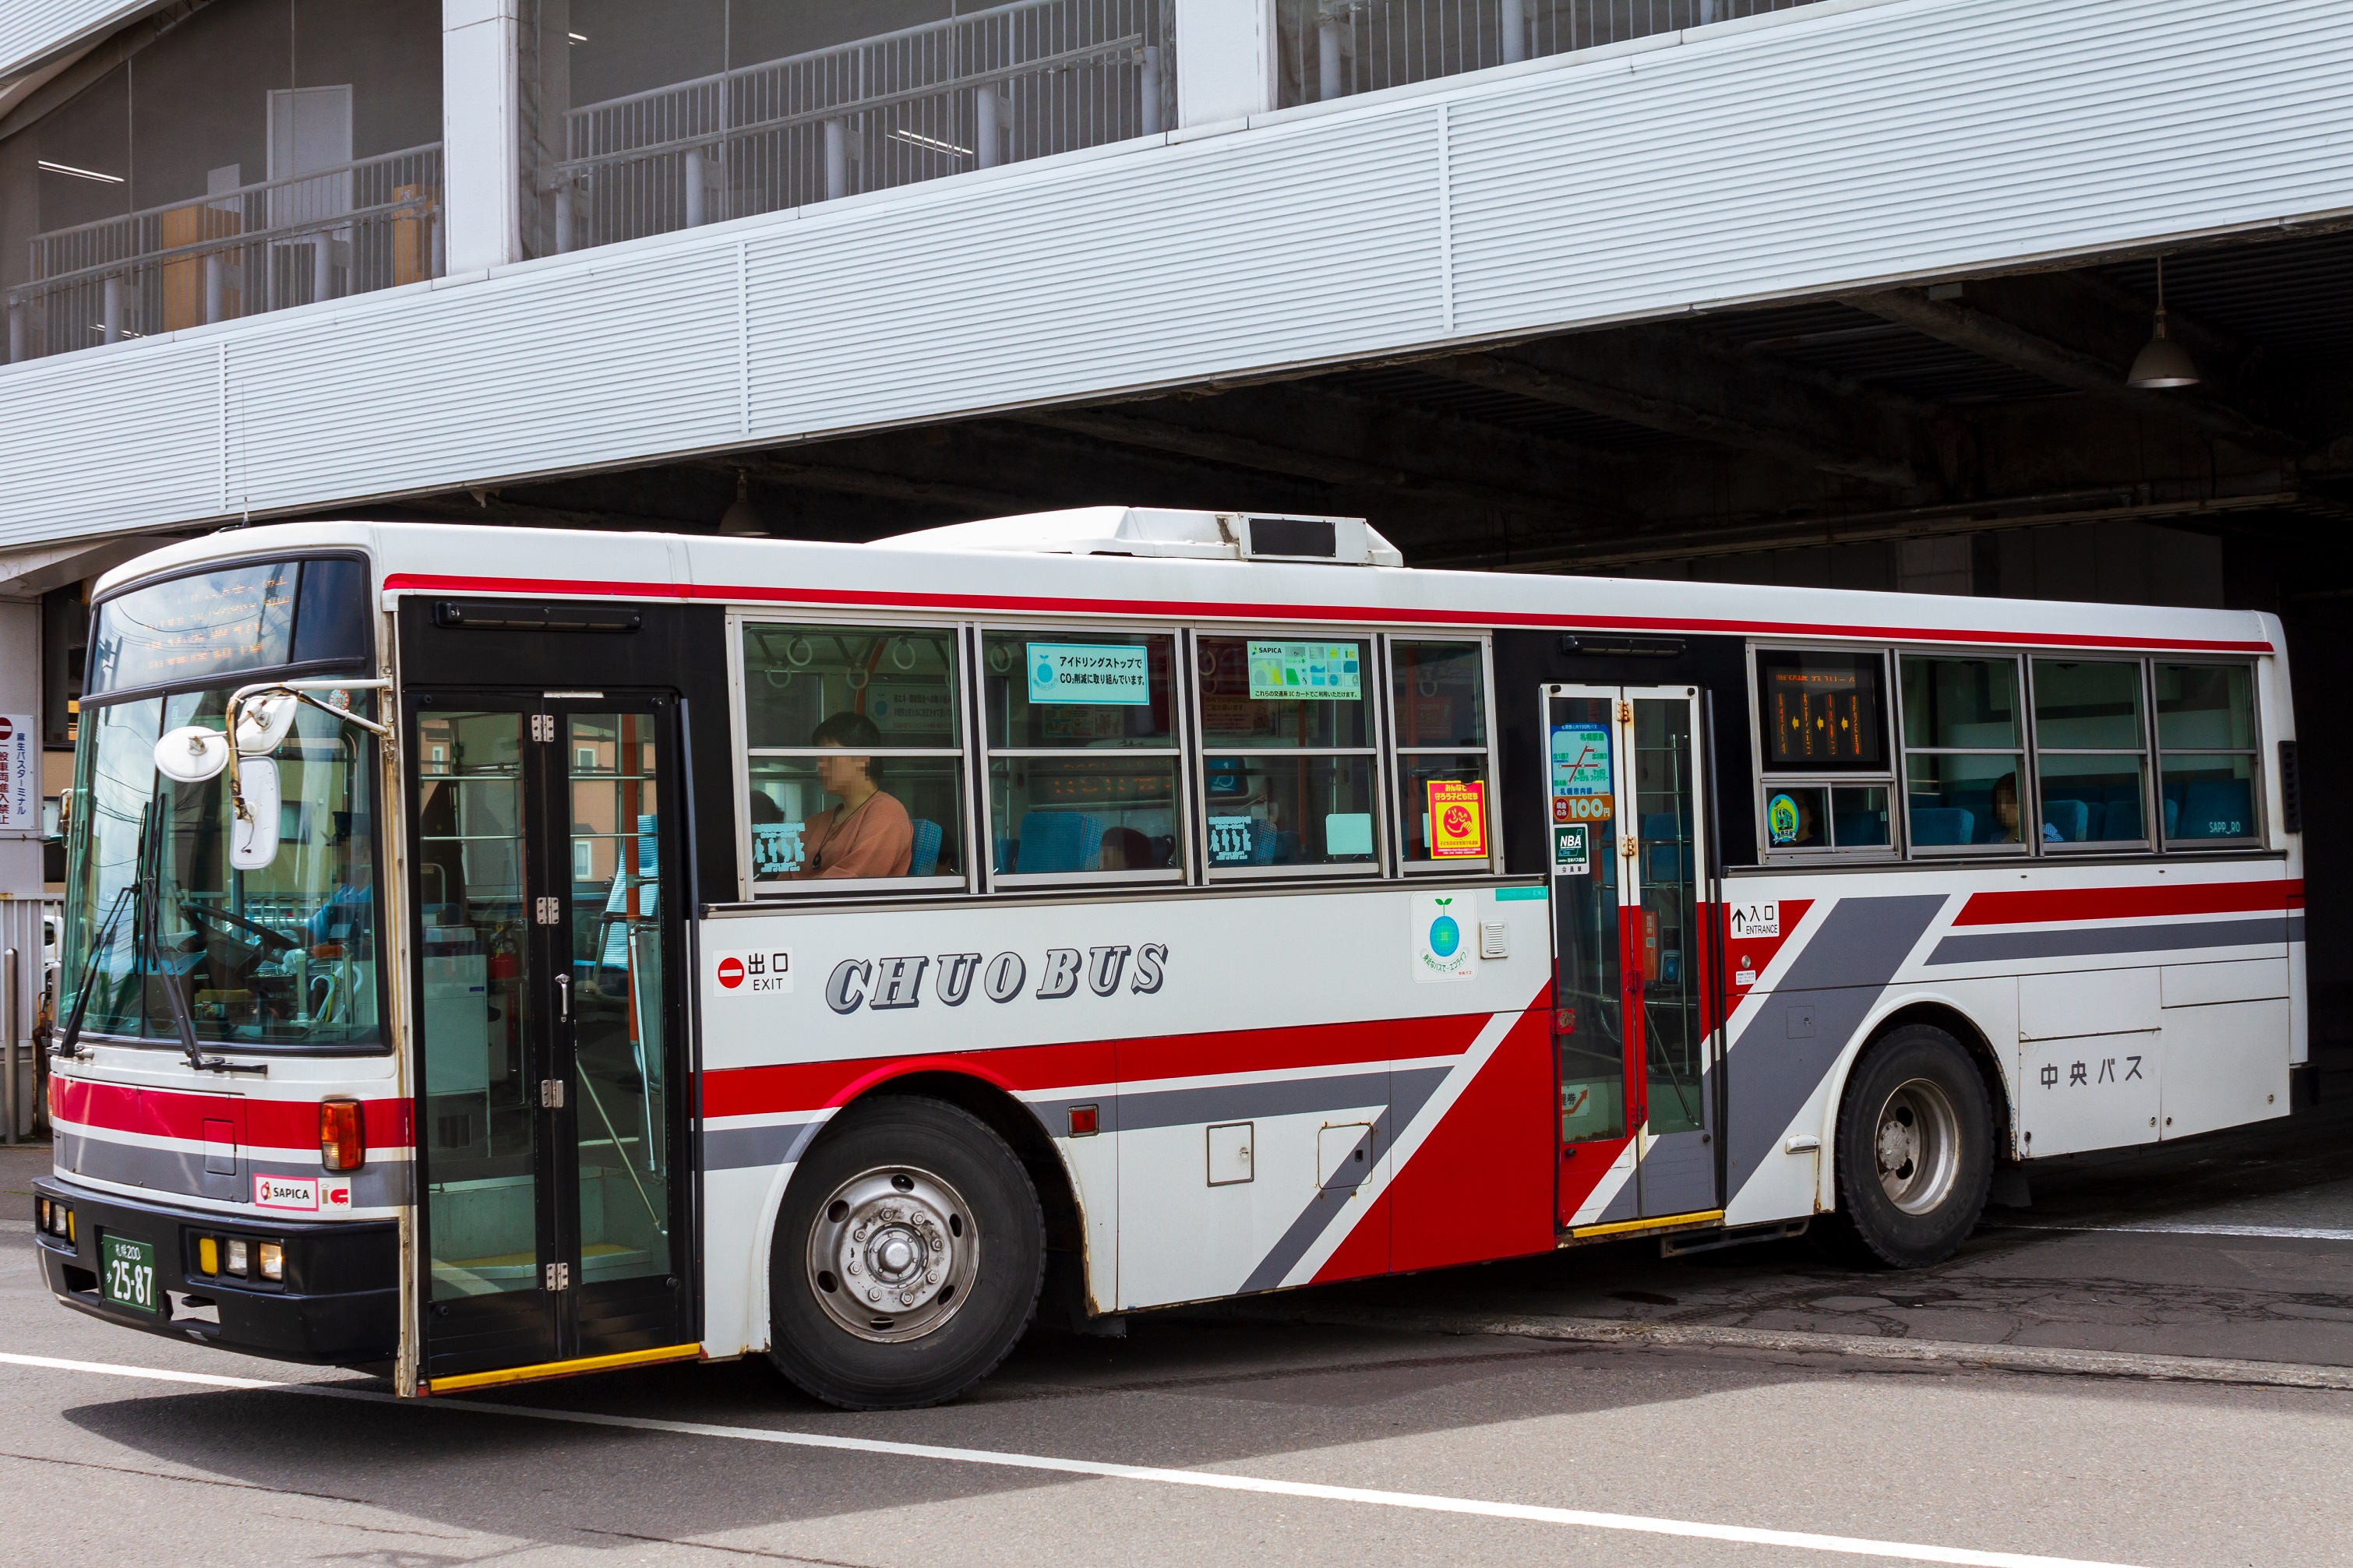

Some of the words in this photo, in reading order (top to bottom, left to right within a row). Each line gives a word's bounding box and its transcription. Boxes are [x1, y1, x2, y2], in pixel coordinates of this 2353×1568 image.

[1060, 656, 1142, 668] アイドリングストップで
[16, 732, 26, 816] 麻生バスターミナル
[1560, 835, 1582, 847] NBA
[1749, 905, 1774, 922] 入口
[1746, 925, 1778, 935] ENTRANCE
[748, 953, 788, 974] 出口
[753, 978, 783, 991] EXIT
[825, 951, 1026, 1014] CHUO
[1036, 943, 1168, 1000] BUS
[2041, 1055, 2143, 1090] 中央バス
[273, 1186, 309, 1200] SAPICA
[111, 1259, 153, 1306] 25-87
